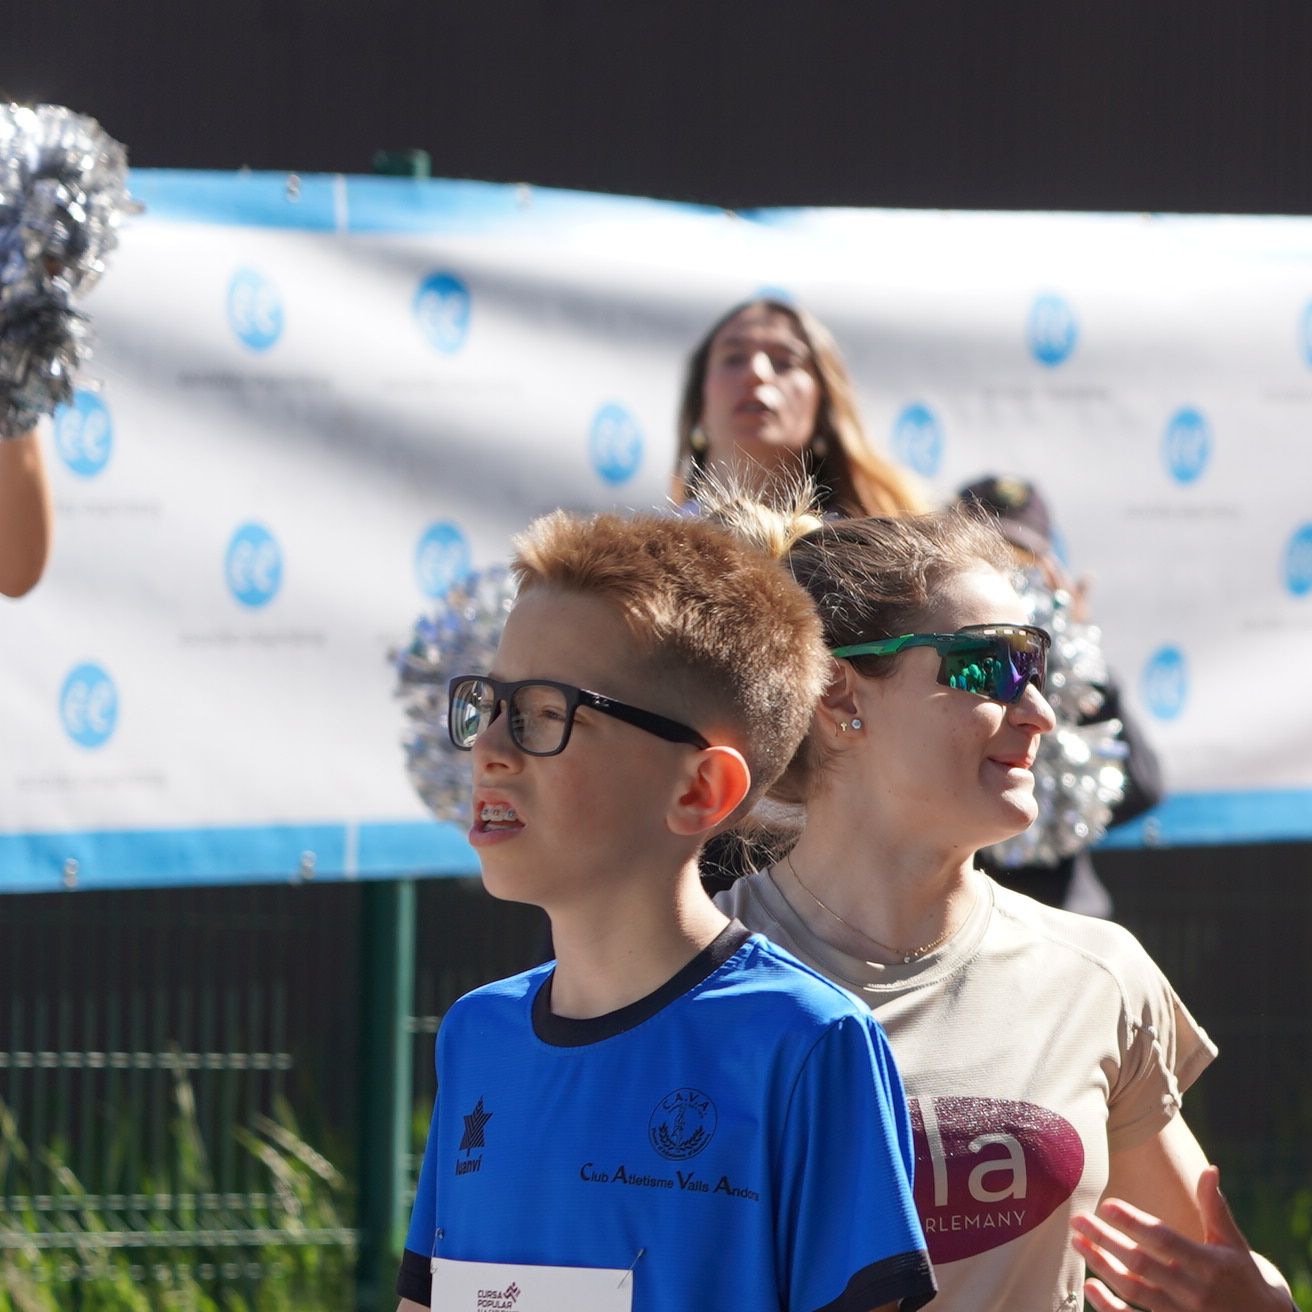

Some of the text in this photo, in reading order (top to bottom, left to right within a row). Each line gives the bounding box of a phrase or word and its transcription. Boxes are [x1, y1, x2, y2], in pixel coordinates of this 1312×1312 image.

[919, 1096, 1033, 1207] la
[455, 1154, 483, 1176] luanvi
[579, 1162, 608, 1183] Club
[611, 1165, 674, 1190] Atletisme
[676, 1171, 709, 1193] Valls
[925, 1210, 1027, 1233] RLEMANY
[477, 1289, 502, 1299] CURSA
[477, 1299, 513, 1309] POPULAR
